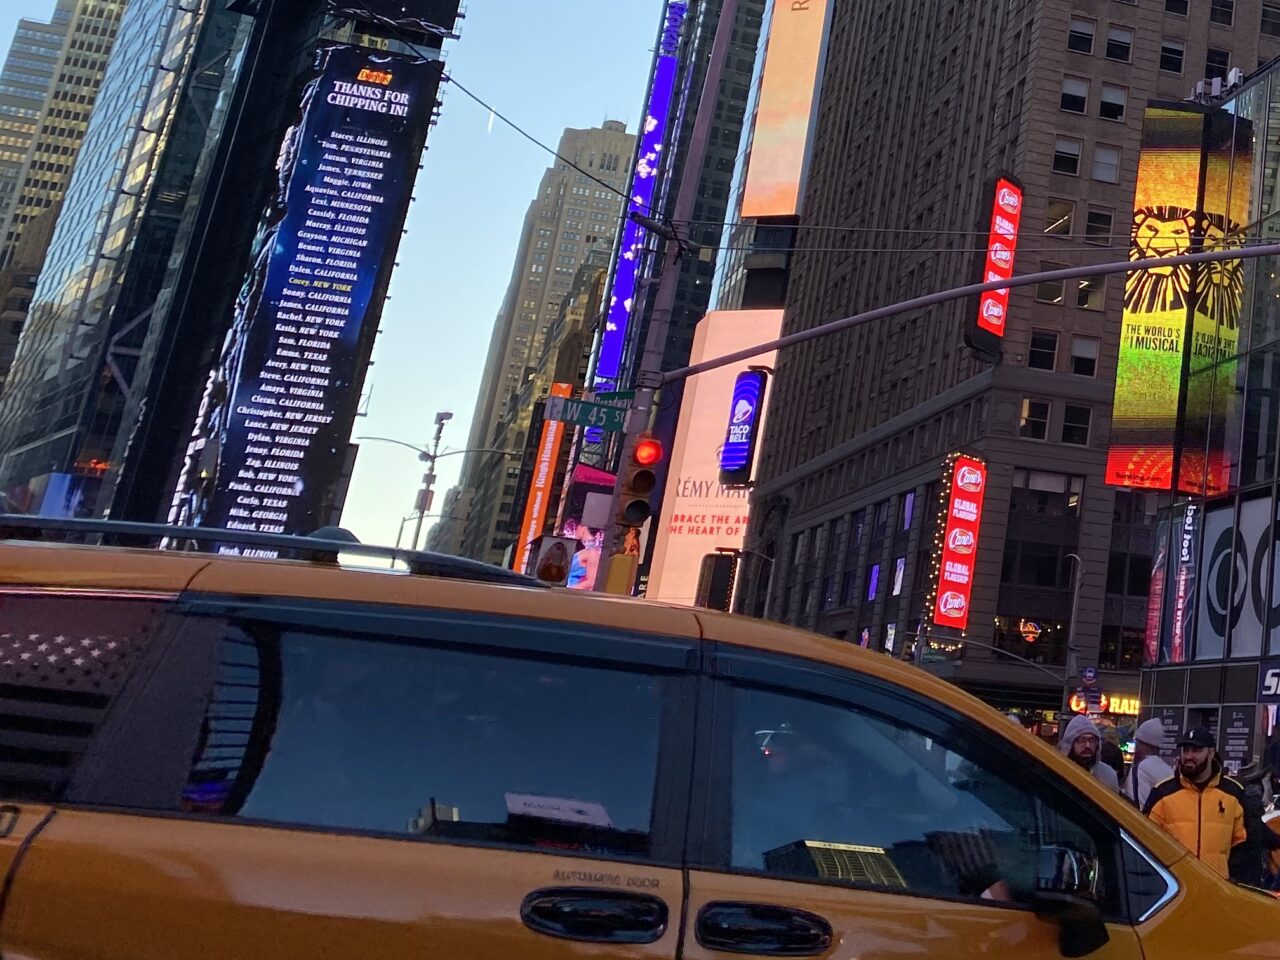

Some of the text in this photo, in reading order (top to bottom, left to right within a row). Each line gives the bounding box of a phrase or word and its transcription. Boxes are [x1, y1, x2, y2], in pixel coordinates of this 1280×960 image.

[334, 81, 409, 104] THANKS FOR
[327, 93, 408, 117] CHIPPING IN!
[356, 136, 388, 146] ILLINOIS
[351, 157, 383, 168] VIRGINIA
[344, 168, 384, 180] TENNESSEE
[352, 181, 371, 189] IOWA
[341, 191, 384, 203] CALIFORNIA
[330, 200, 371, 212] MINNESOTA
[338, 213, 369, 224] FLORIDA
[334, 224, 366, 235] ILLINOIS
[330, 236, 368, 247] MICHIGAN
[328, 247, 360, 258] VIRGINIA
[325, 259, 357, 269] FLORIDA
[314, 269, 357, 280] CALIFORNIA
[308, 292, 352, 304] CALIFORNIA
[305, 304, 349, 315] CALIFORNIA
[305, 316, 324, 324] NEW
[325, 319, 346, 327] YORK
[299, 327, 340, 338] NEW YORK
[1126, 324, 1181, 338] THE WORLD'S
[298, 339, 331, 349] FLORIDA
[1135, 337, 1180, 352] MUSICAL
[304, 352, 328, 361] TEXAS
[310, 365, 331, 373] YORK
[284, 375, 329, 386] CALIFORNIA
[290, 387, 324, 398] VIRGINIA
[279, 399, 324, 410] CALIFORNIA
[284, 412, 304, 420] NEW
[303, 414, 333, 424] JERSEY
[567, 402, 582, 420] W
[588, 407, 608, 426] 45
[270, 423, 289, 431] NEW
[289, 425, 319, 435] JERSEY
[730, 425, 749, 433] TACO
[275, 436, 310, 446] VIRGINIA
[729, 434, 747, 443] BELL
[271, 448, 304, 458] FLORIDA
[264, 460, 299, 470] ILLINOIS
[262, 499, 288, 507] TEXAS
[954, 498, 977, 513] GLOBAL
[252, 511, 288, 522] GEORGIA
[711, 515, 730, 524] THE
[952, 509, 977, 522] FLAGSHIP
[259, 524, 285, 533] TEXAS
[688, 526, 740, 536] HEART OF
[945, 561, 969, 575] GLOBAL
[944, 572, 968, 584] FLAGSHIP
